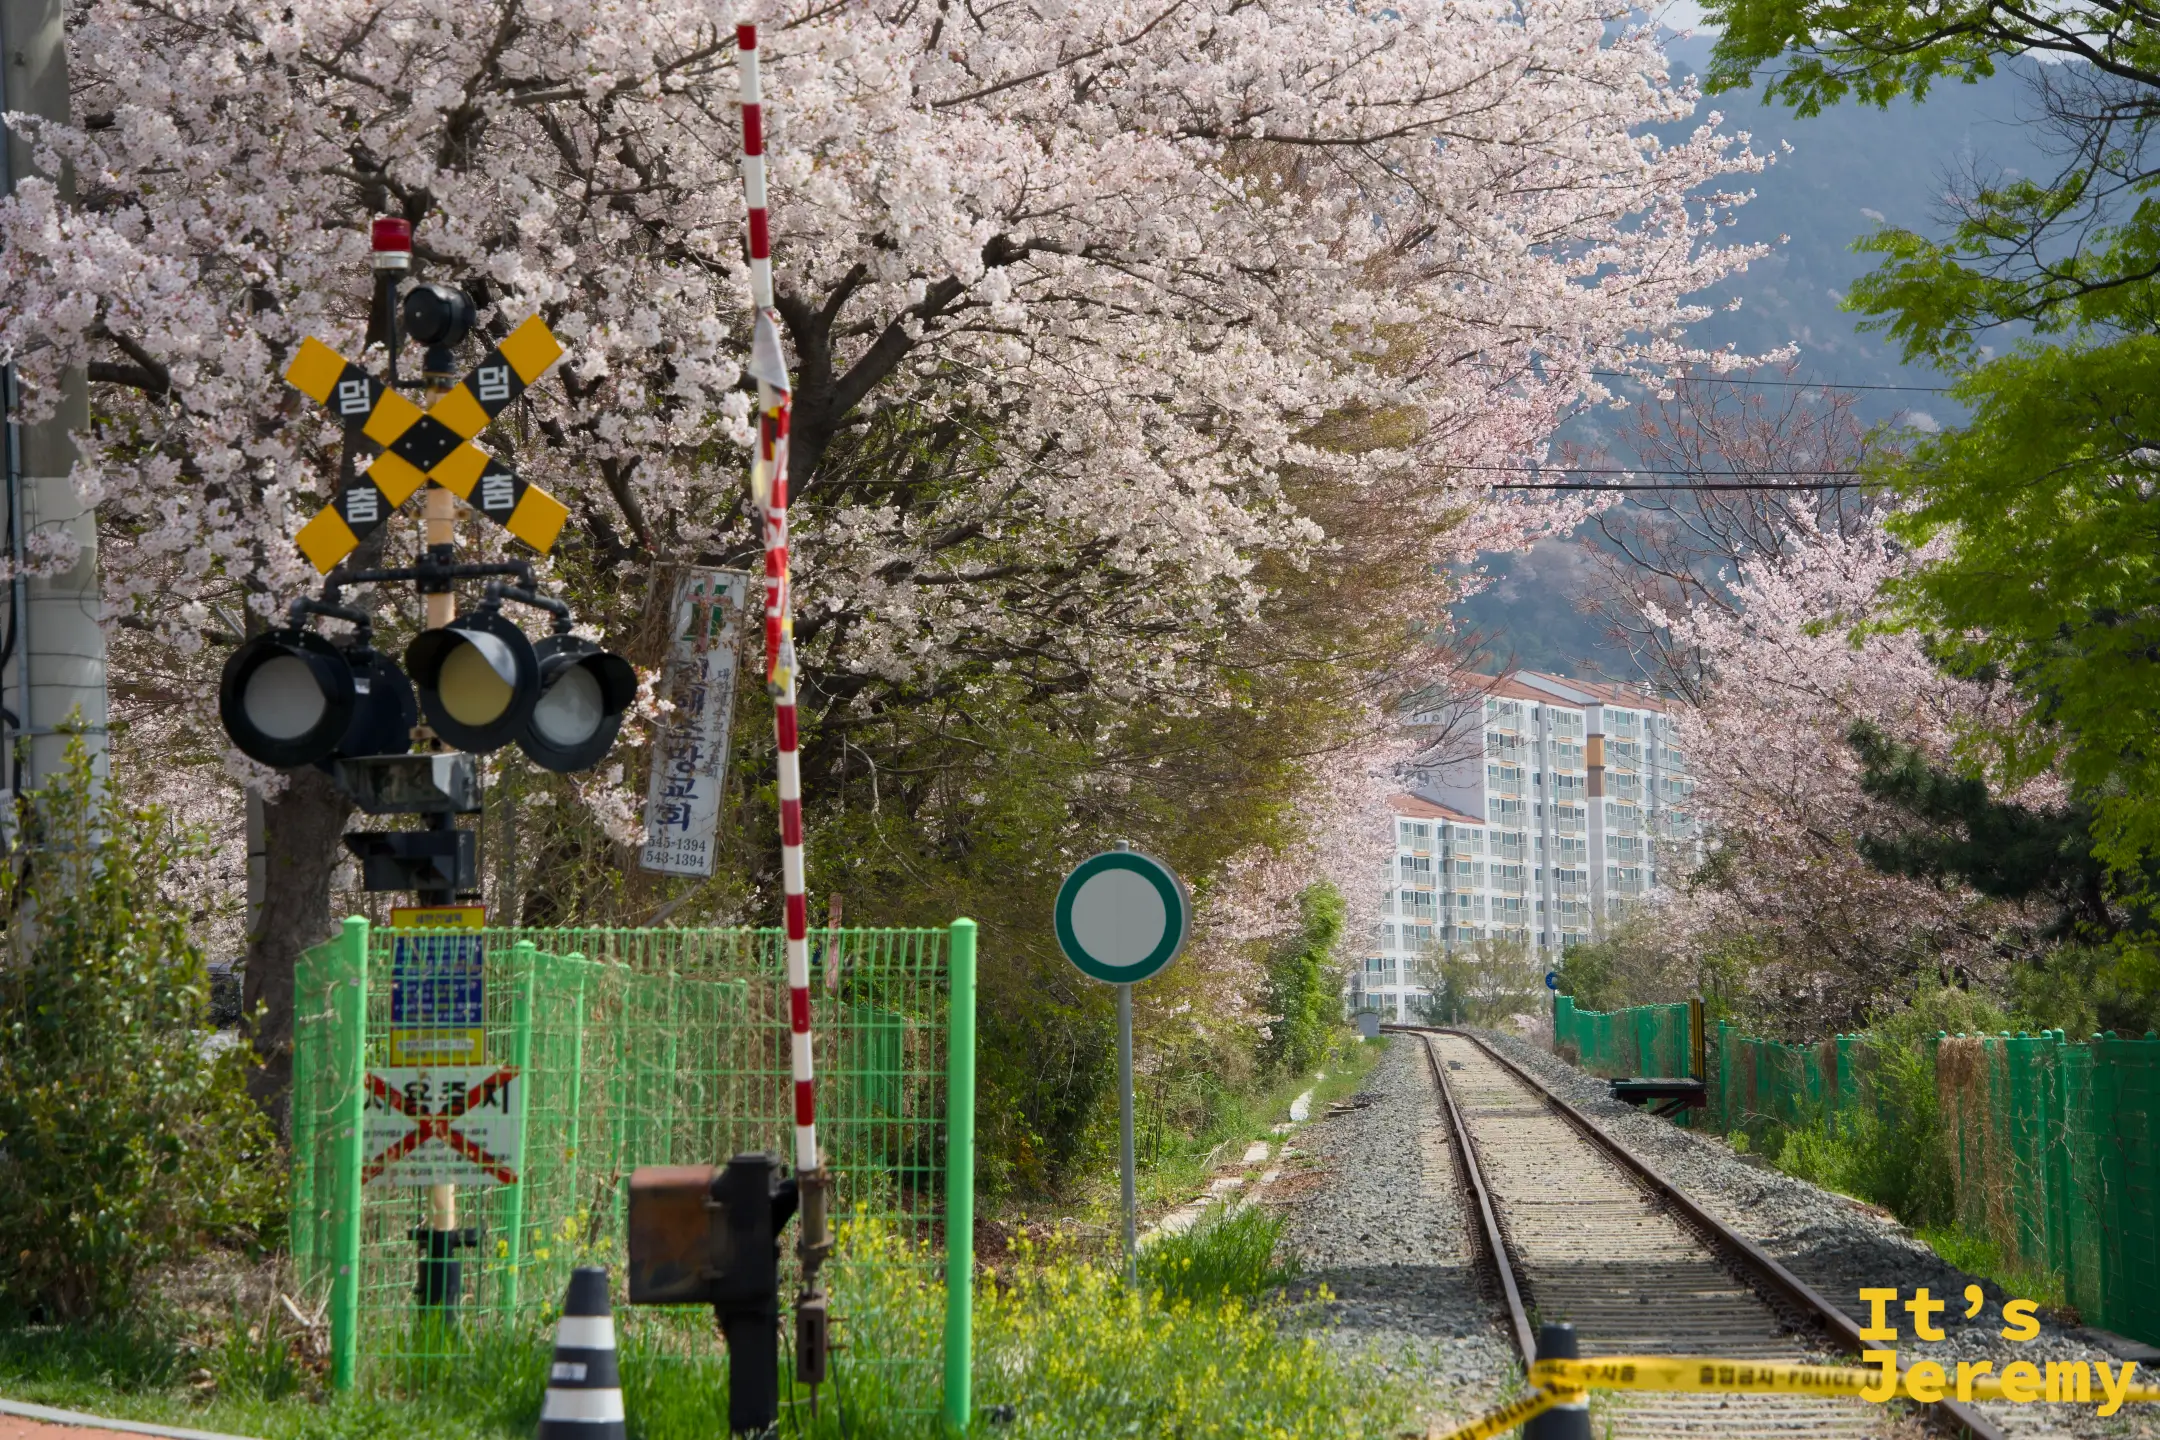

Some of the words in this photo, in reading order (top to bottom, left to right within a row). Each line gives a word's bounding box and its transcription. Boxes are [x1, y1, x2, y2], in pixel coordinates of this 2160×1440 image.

[338, 378, 371, 415] 멈
[478, 365, 510, 401] 멈
[346, 487, 378, 523] 춤
[482, 473, 514, 510] 춤
[646, 850, 704, 867] 543-1394
[648, 835, 706, 852] 545-1394
